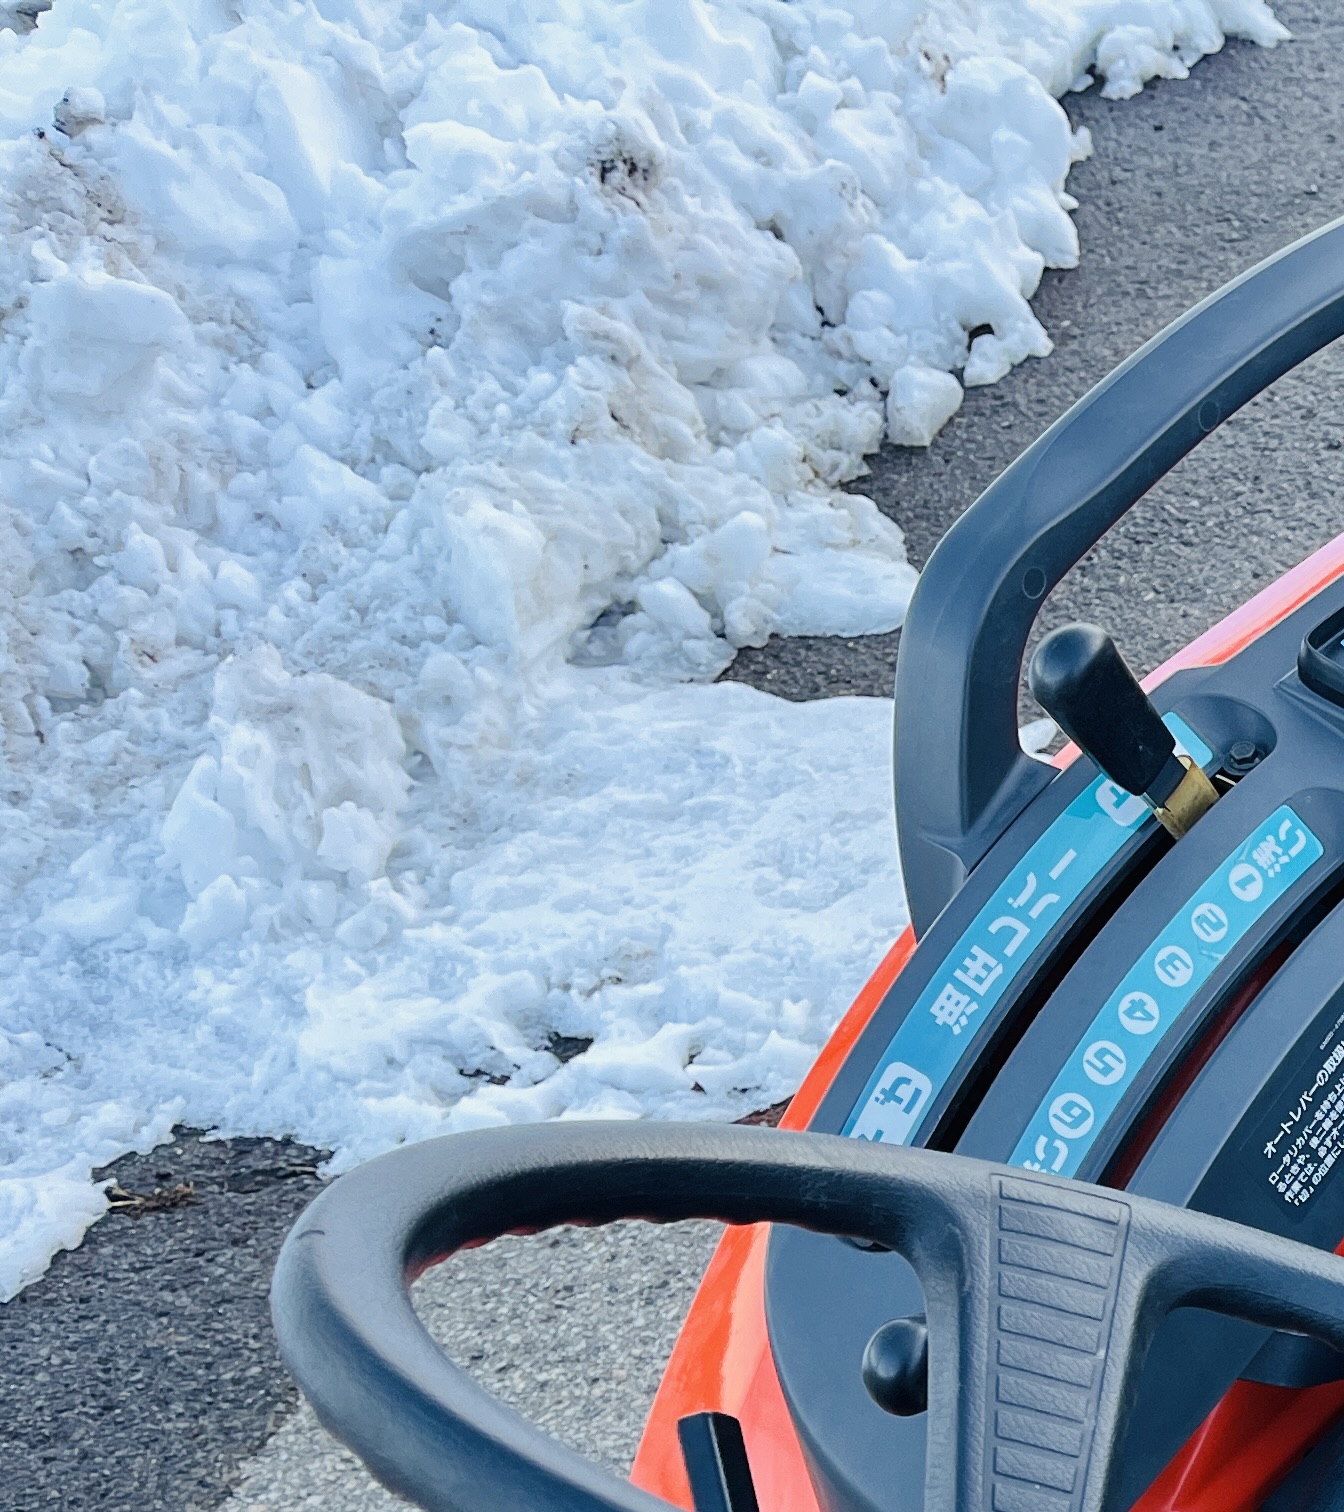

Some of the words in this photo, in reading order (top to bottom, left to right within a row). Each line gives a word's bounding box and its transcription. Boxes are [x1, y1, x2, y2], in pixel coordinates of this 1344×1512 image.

[930, 849, 1076, 1038] 油圧レバー
